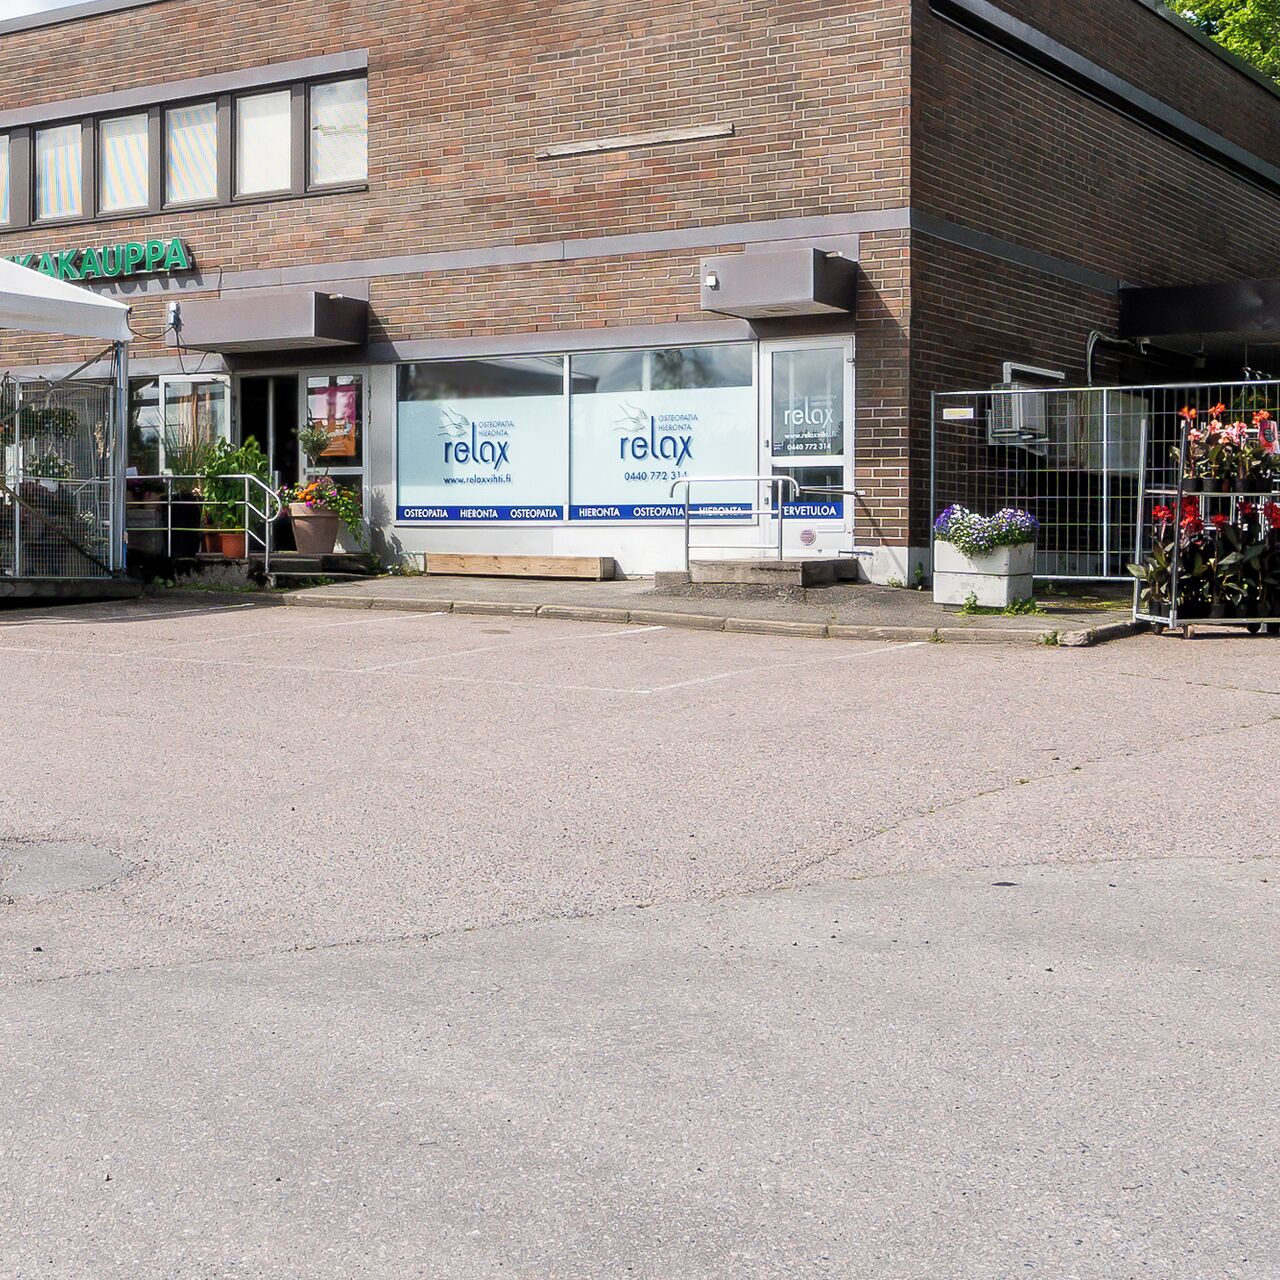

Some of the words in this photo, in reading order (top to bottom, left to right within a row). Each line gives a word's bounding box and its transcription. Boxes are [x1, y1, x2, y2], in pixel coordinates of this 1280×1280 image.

[784, 395, 834, 429] relax
[658, 414, 699, 422] OSTEOPATIA
[478, 421, 514, 429] OSTEOPATIA
[658, 424, 692, 432] HIERONTA
[444, 421, 510, 470] relax
[620, 415, 694, 467] relax
[804, 442, 818, 451] 772
[443, 474, 511, 484] www.relaxvihti.fi
[624, 471, 647, 481] 0440
[650, 471, 668, 481] 772
[404, 508, 448, 518] OSTEOPATIA
[460, 508, 498, 518] HIERONTA
[510, 508, 558, 518] OSTEOPATIA
[579, 507, 620, 517] HIERONTA
[633, 507, 685, 517] OSTEOPATIA
